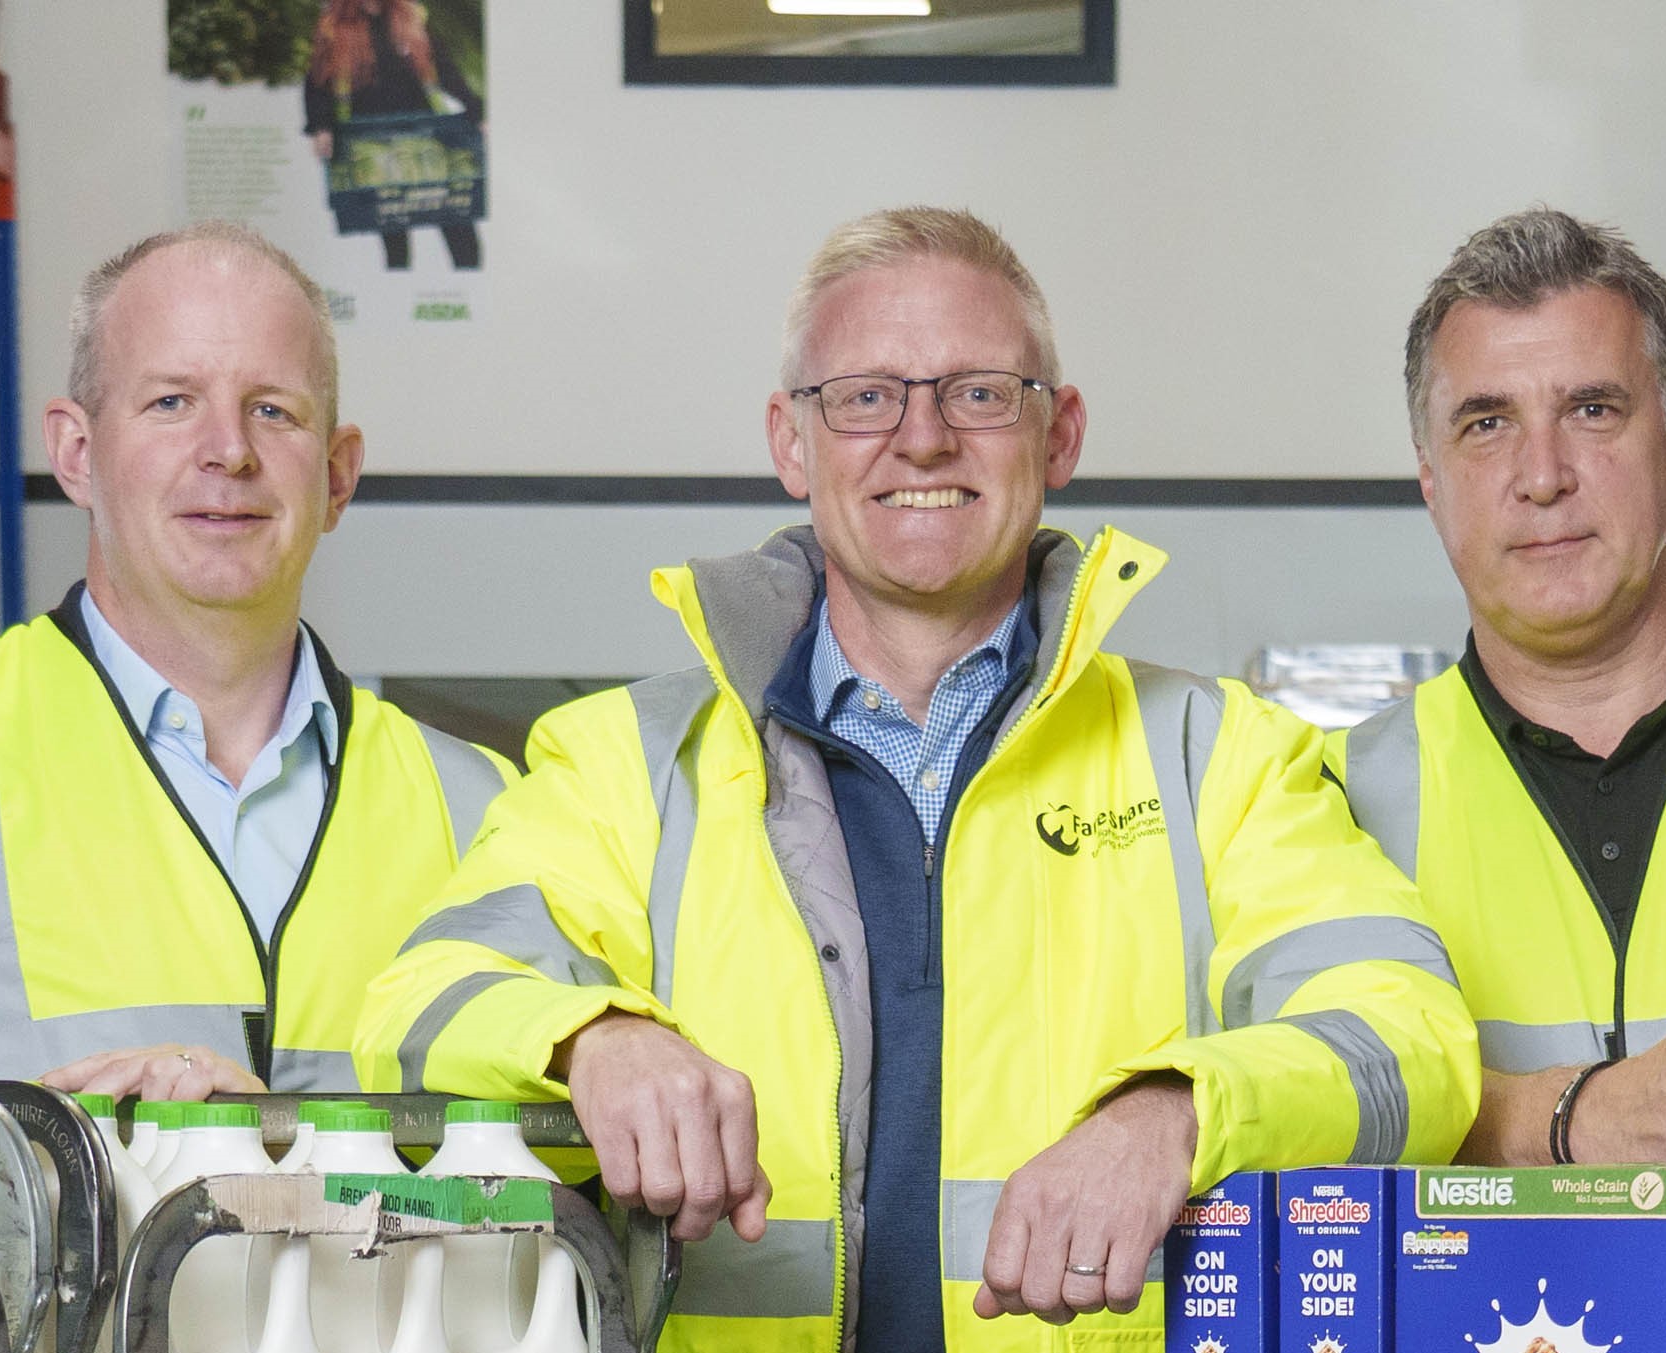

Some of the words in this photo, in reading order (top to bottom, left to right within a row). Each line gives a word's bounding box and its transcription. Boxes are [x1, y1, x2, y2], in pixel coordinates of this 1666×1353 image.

[1428, 1176, 1514, 1206] Nestlé
[1552, 1179, 1591, 1193] Whole
[1594, 1179, 1628, 1193] Grain
[1288, 1197, 1371, 1223] Shreddies
[1199, 1228, 1241, 1237] ORIGINAL
[1317, 1227, 1360, 1235] ORIGINAL
[1195, 1251, 1225, 1270] ON
[1313, 1250, 1343, 1268] ON
[1183, 1275, 1237, 1293] YOUR
[1300, 1274, 1356, 1292] YOUR
[1184, 1299, 1235, 1317] SIDE!
[1301, 1298, 1354, 1316] SIDE!
